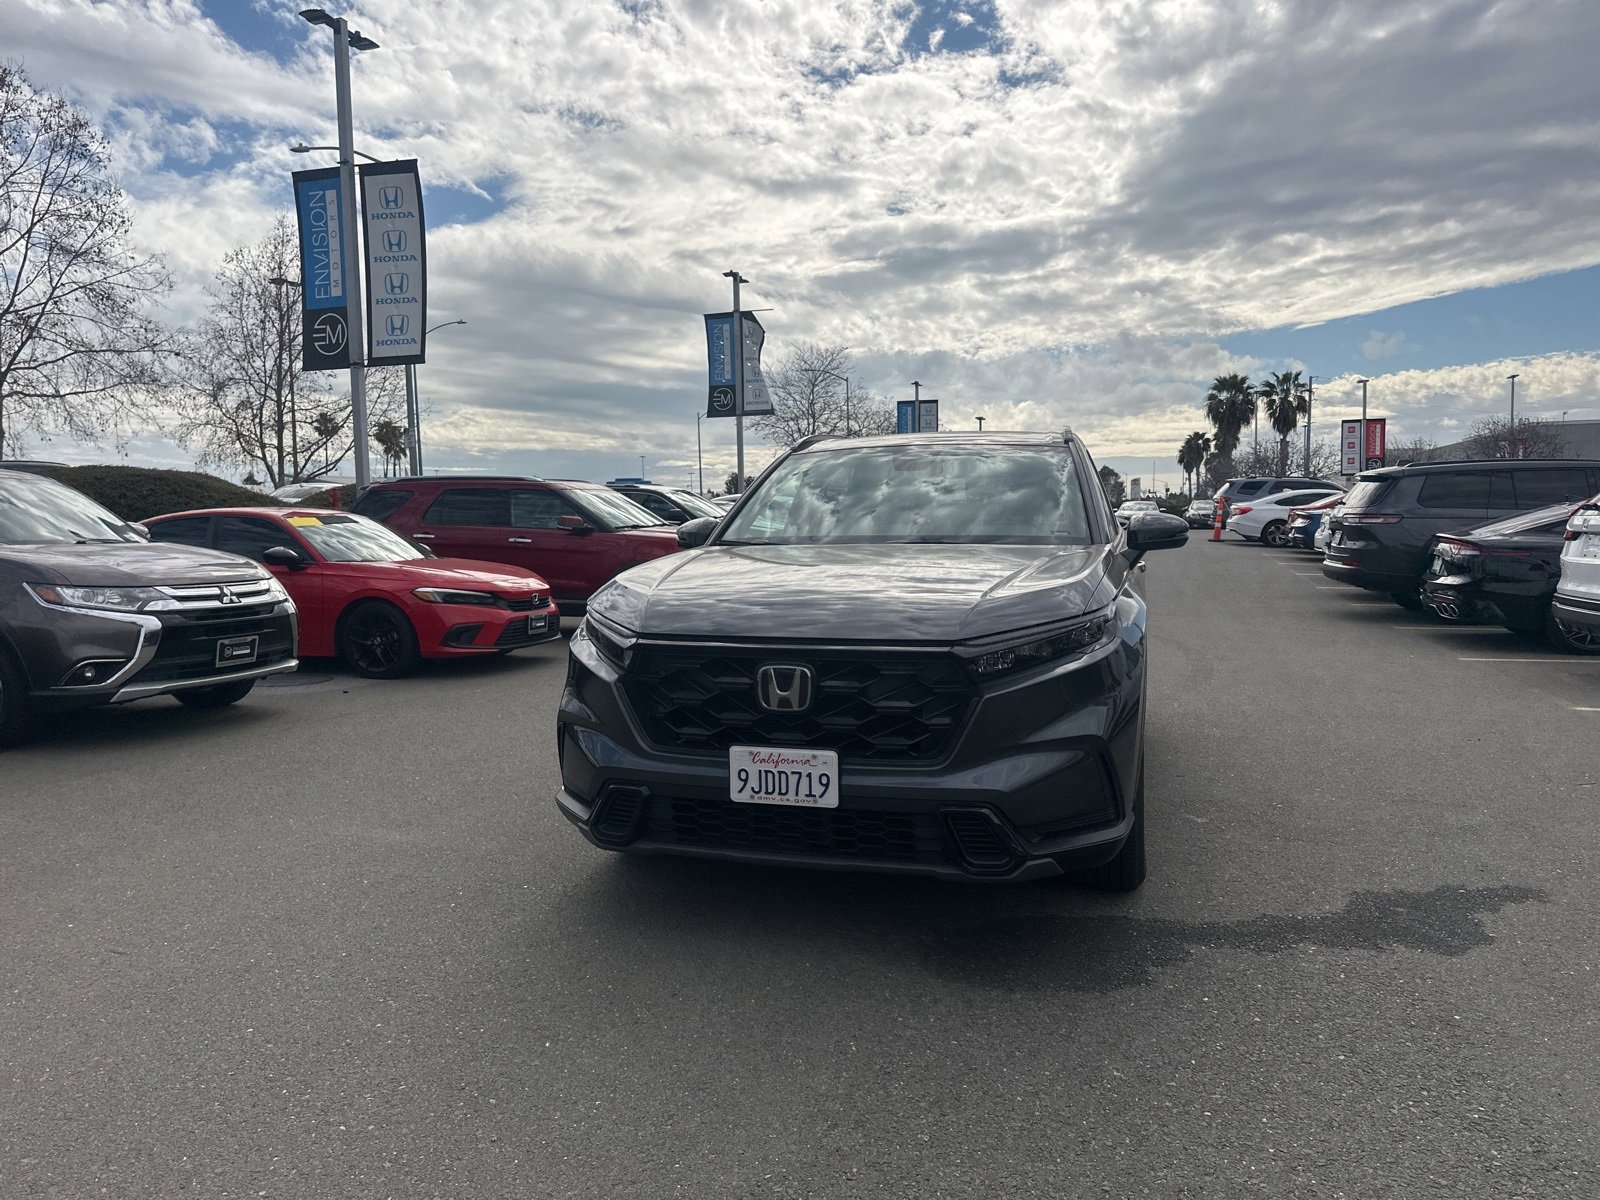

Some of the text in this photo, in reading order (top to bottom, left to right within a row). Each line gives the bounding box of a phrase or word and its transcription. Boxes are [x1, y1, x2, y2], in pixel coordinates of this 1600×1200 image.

[371, 212, 415, 221] HONDA
[308, 190, 330, 300] ENVISION
[328, 199, 341, 288] MOTORS
[374, 255, 417, 263] HONDA
[376, 297, 418, 305] HONDA
[376, 337, 417, 346] HONDA
[713, 324, 725, 381] ENVISION
[752, 751, 817, 769] California
[737, 768, 831, 799] 9JDD719
[757, 796, 812, 804] dmv.ca.gov
